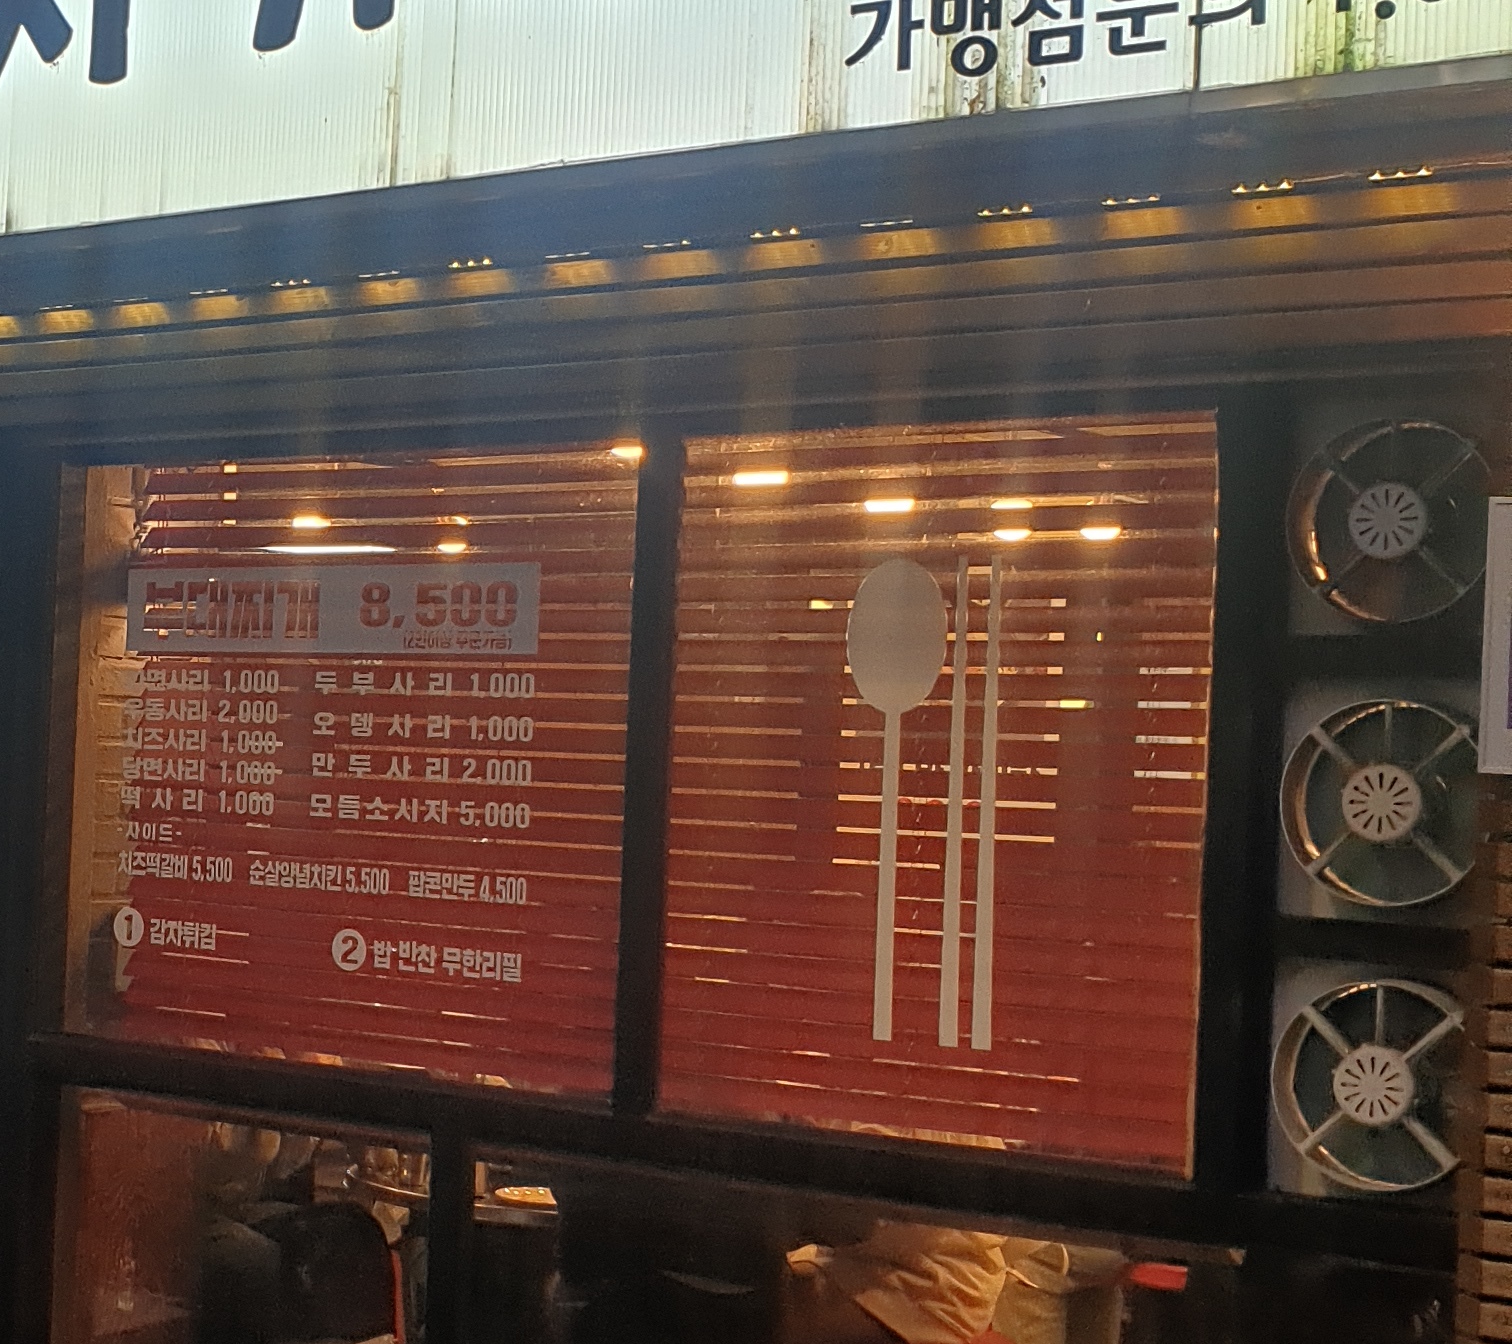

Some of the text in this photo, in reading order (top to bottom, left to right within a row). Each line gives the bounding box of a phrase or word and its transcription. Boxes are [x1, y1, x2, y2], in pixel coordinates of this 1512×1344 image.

[358, 579, 520, 630] 8,500
[223, 669, 279, 694] 1,000
[469, 672, 535, 698] 1,000
[217, 699, 278, 724] 2,000
[221, 729, 277, 755] 1,000
[468, 715, 534, 742] 1,000
[219, 759, 276, 785] 1,000
[461, 757, 532, 787] 2,000
[218, 789, 275, 816] 1,000
[459, 800, 531, 829] 5,000
[117, 849, 527, 905] 치즈떡갈비 5,500 순살양념치킨 5,500 팝콘만두 4,500
[441, 946, 523, 983] 무한리필
